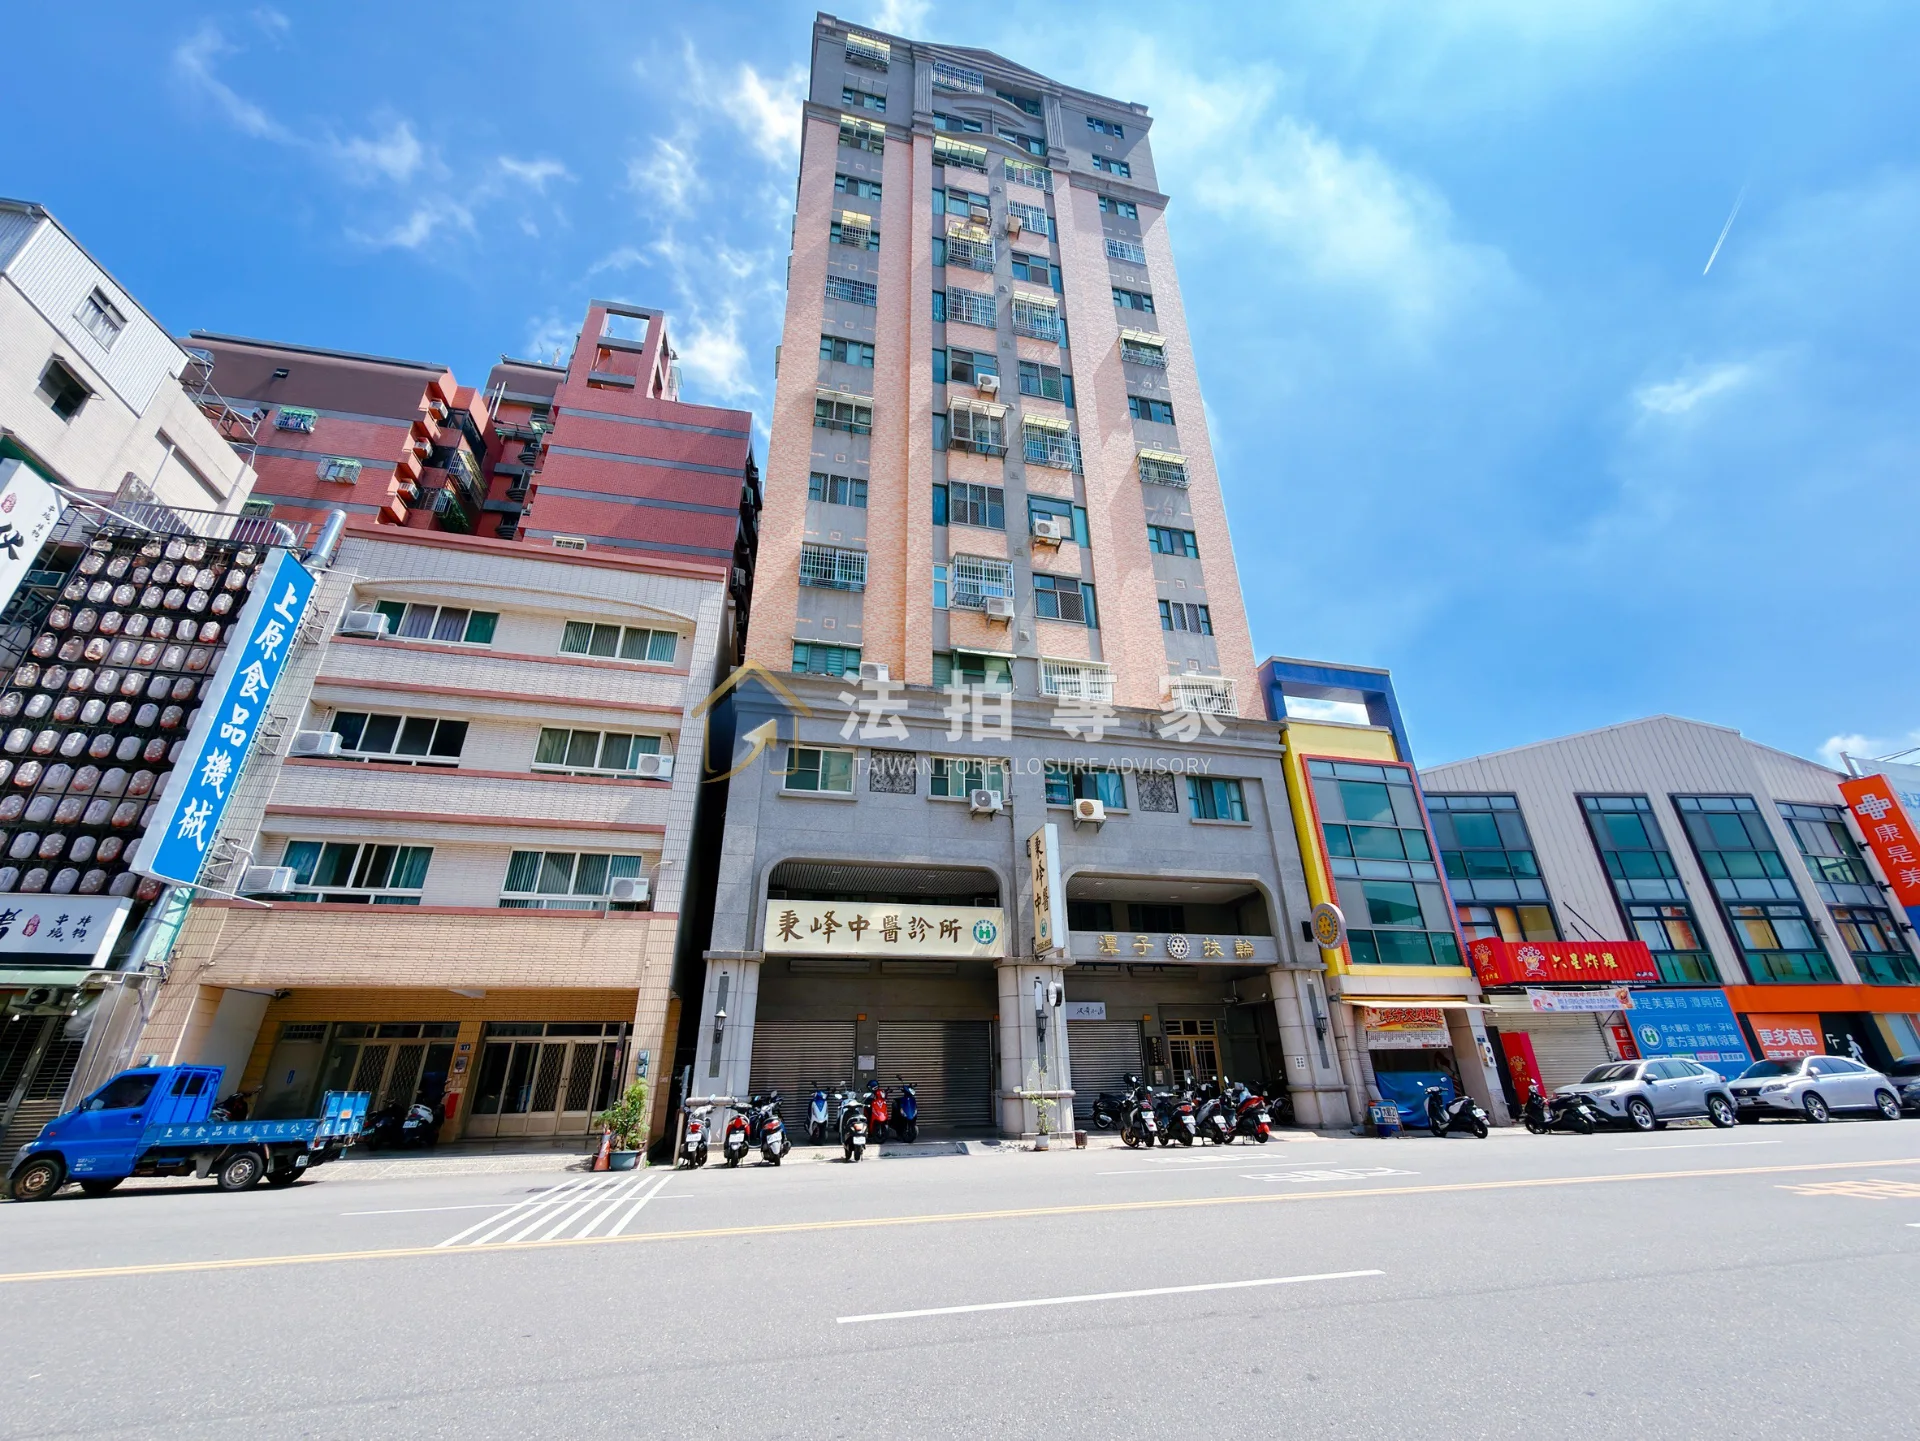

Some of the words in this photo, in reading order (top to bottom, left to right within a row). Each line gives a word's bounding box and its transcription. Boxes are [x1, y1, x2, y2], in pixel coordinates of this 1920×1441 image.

[177, 582, 298, 852] 上原食品機械
[1874, 823, 1920, 888] 康是美
[776, 909, 963, 944] 秉峰中醫診所
[1098, 934, 1154, 956] 潭子
[1202, 936, 1255, 959] 扶輪
[1551, 952, 1618, 970] 六星炸雞
[1757, 1028, 1818, 1046] 更多商品
